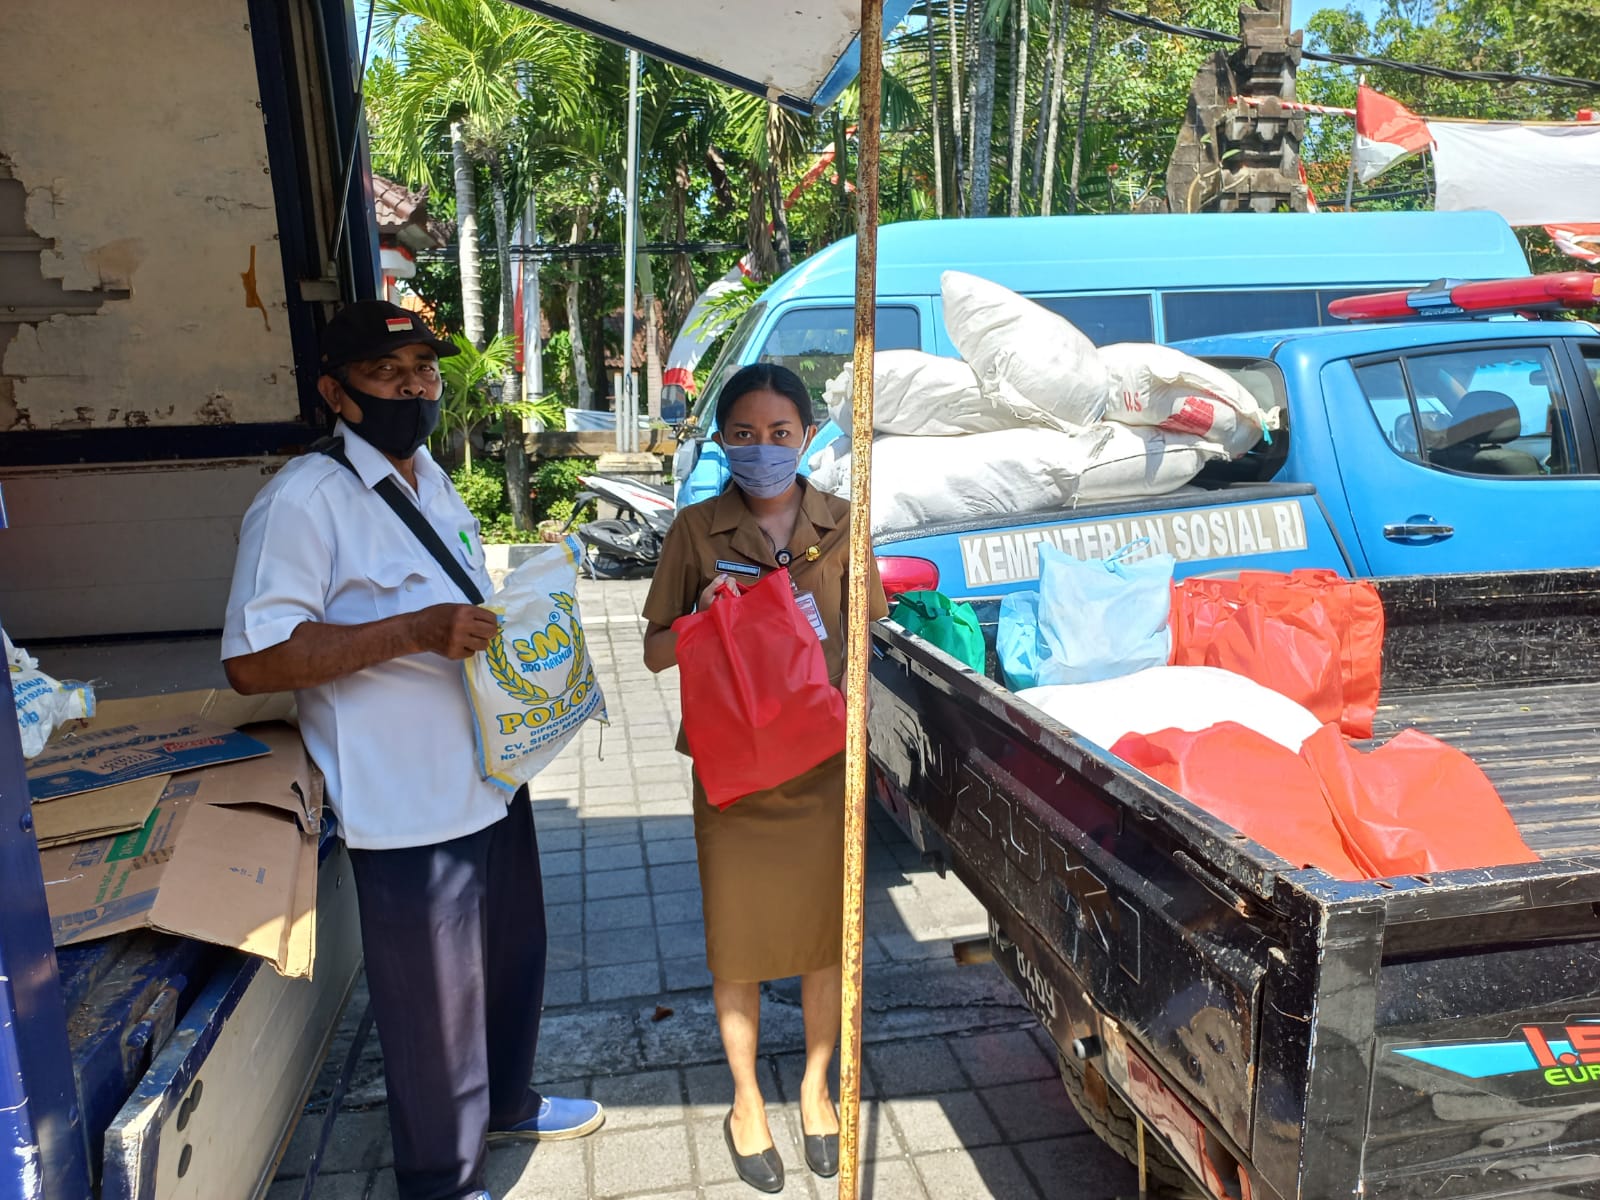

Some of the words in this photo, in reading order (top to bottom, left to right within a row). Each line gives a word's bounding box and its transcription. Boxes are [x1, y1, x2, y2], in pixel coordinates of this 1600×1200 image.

[1172, 508, 1273, 559] SOSIAL
[1273, 503, 1304, 548] RI
[512, 623, 571, 663] SM
[521, 663, 541, 673] SIDO
[530, 730, 559, 745] SIDO
